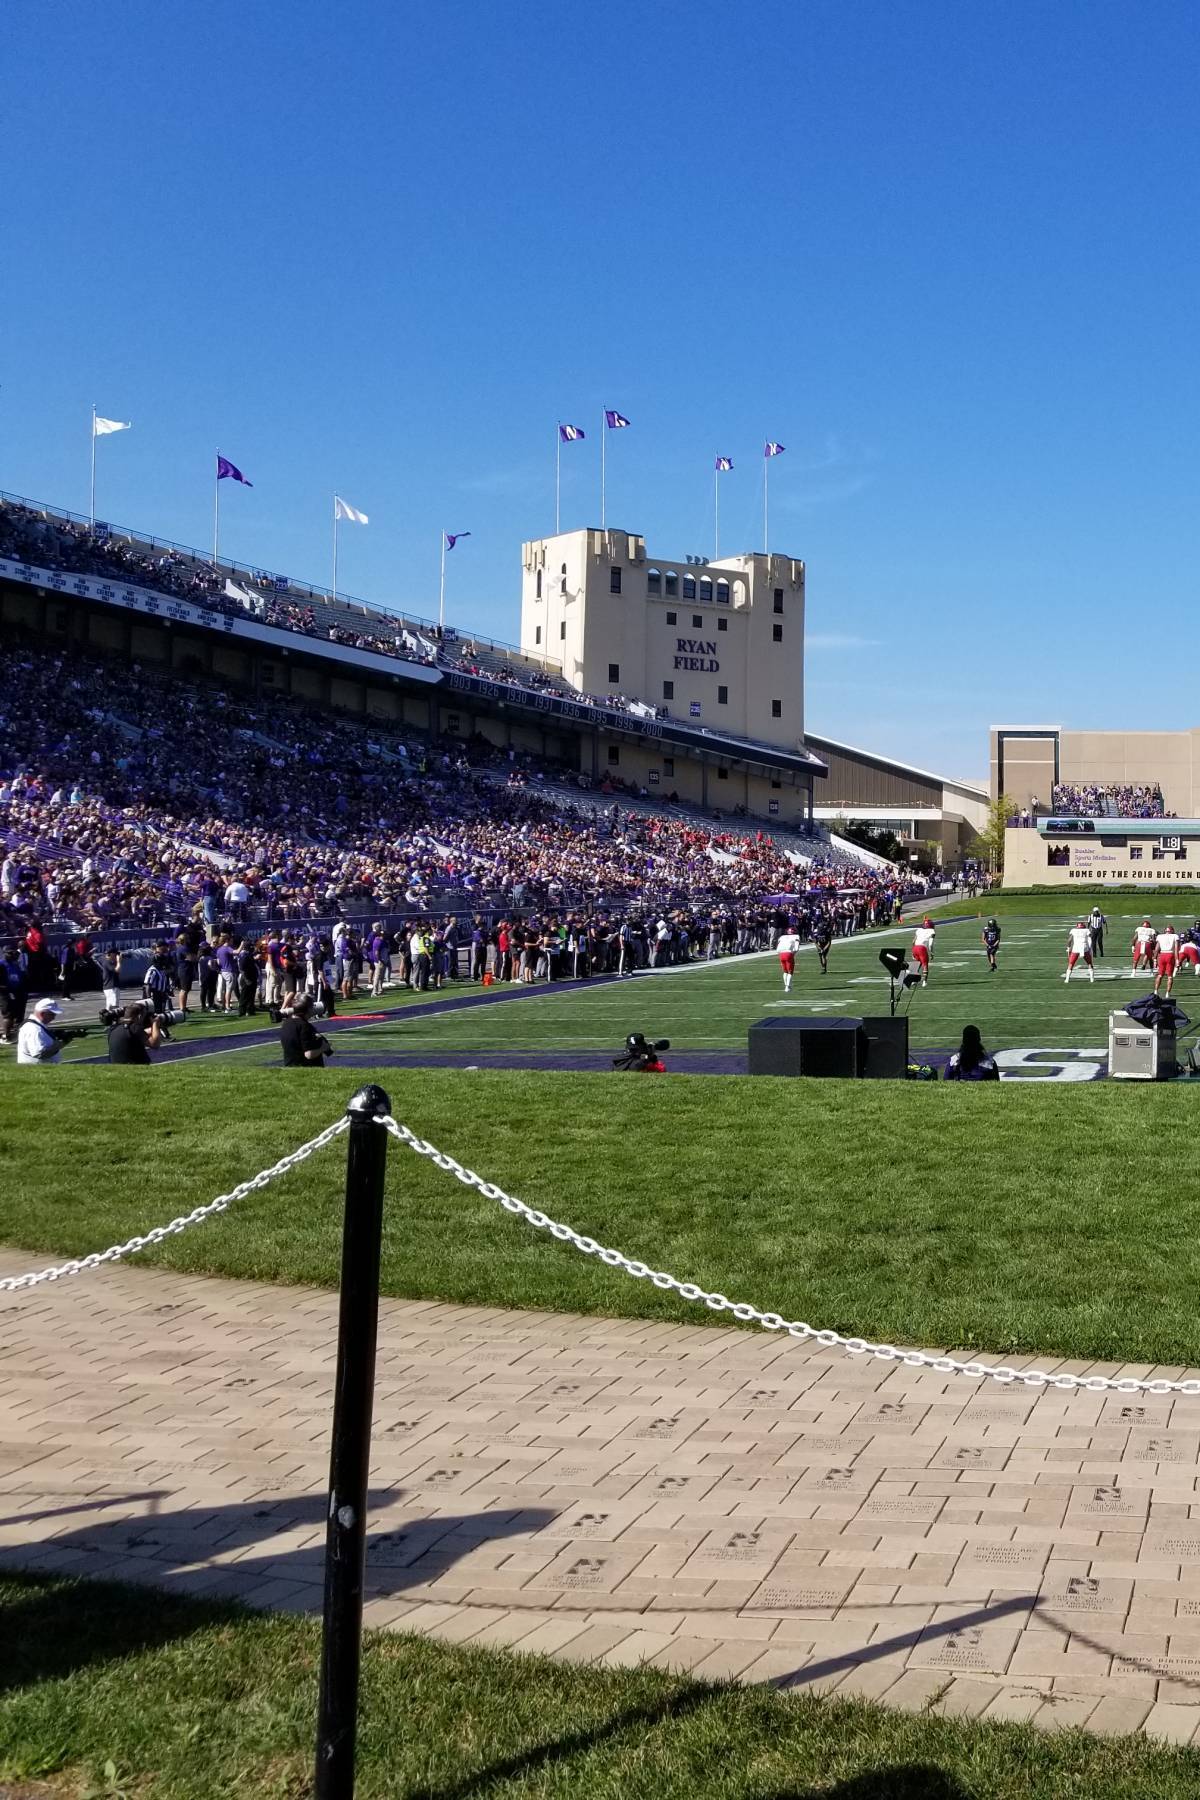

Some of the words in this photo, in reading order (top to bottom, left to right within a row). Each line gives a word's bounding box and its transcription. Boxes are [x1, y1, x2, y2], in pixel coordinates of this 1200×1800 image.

[676, 638, 717, 656] RYAN
[673, 655, 720, 673] FIELD
[450, 675, 471, 690] 1903
[478, 681, 499, 697] 1926
[507, 688, 528, 704] 1930
[560, 702, 580, 718] 1936
[588, 708, 608, 724] 1995
[615, 715, 634, 731] 1996
[641, 722, 663, 737] 2000
[1167, 838, 1178, 848] 18
[1069, 870, 1093, 878] HOME
[1096, 870, 1107, 878] OF
[1111, 870, 1129, 878] THE
[1132, 871, 1153, 879] 2018
[1156, 871, 1171, 879] BIG
[1175, 871, 1193, 879] TEN
